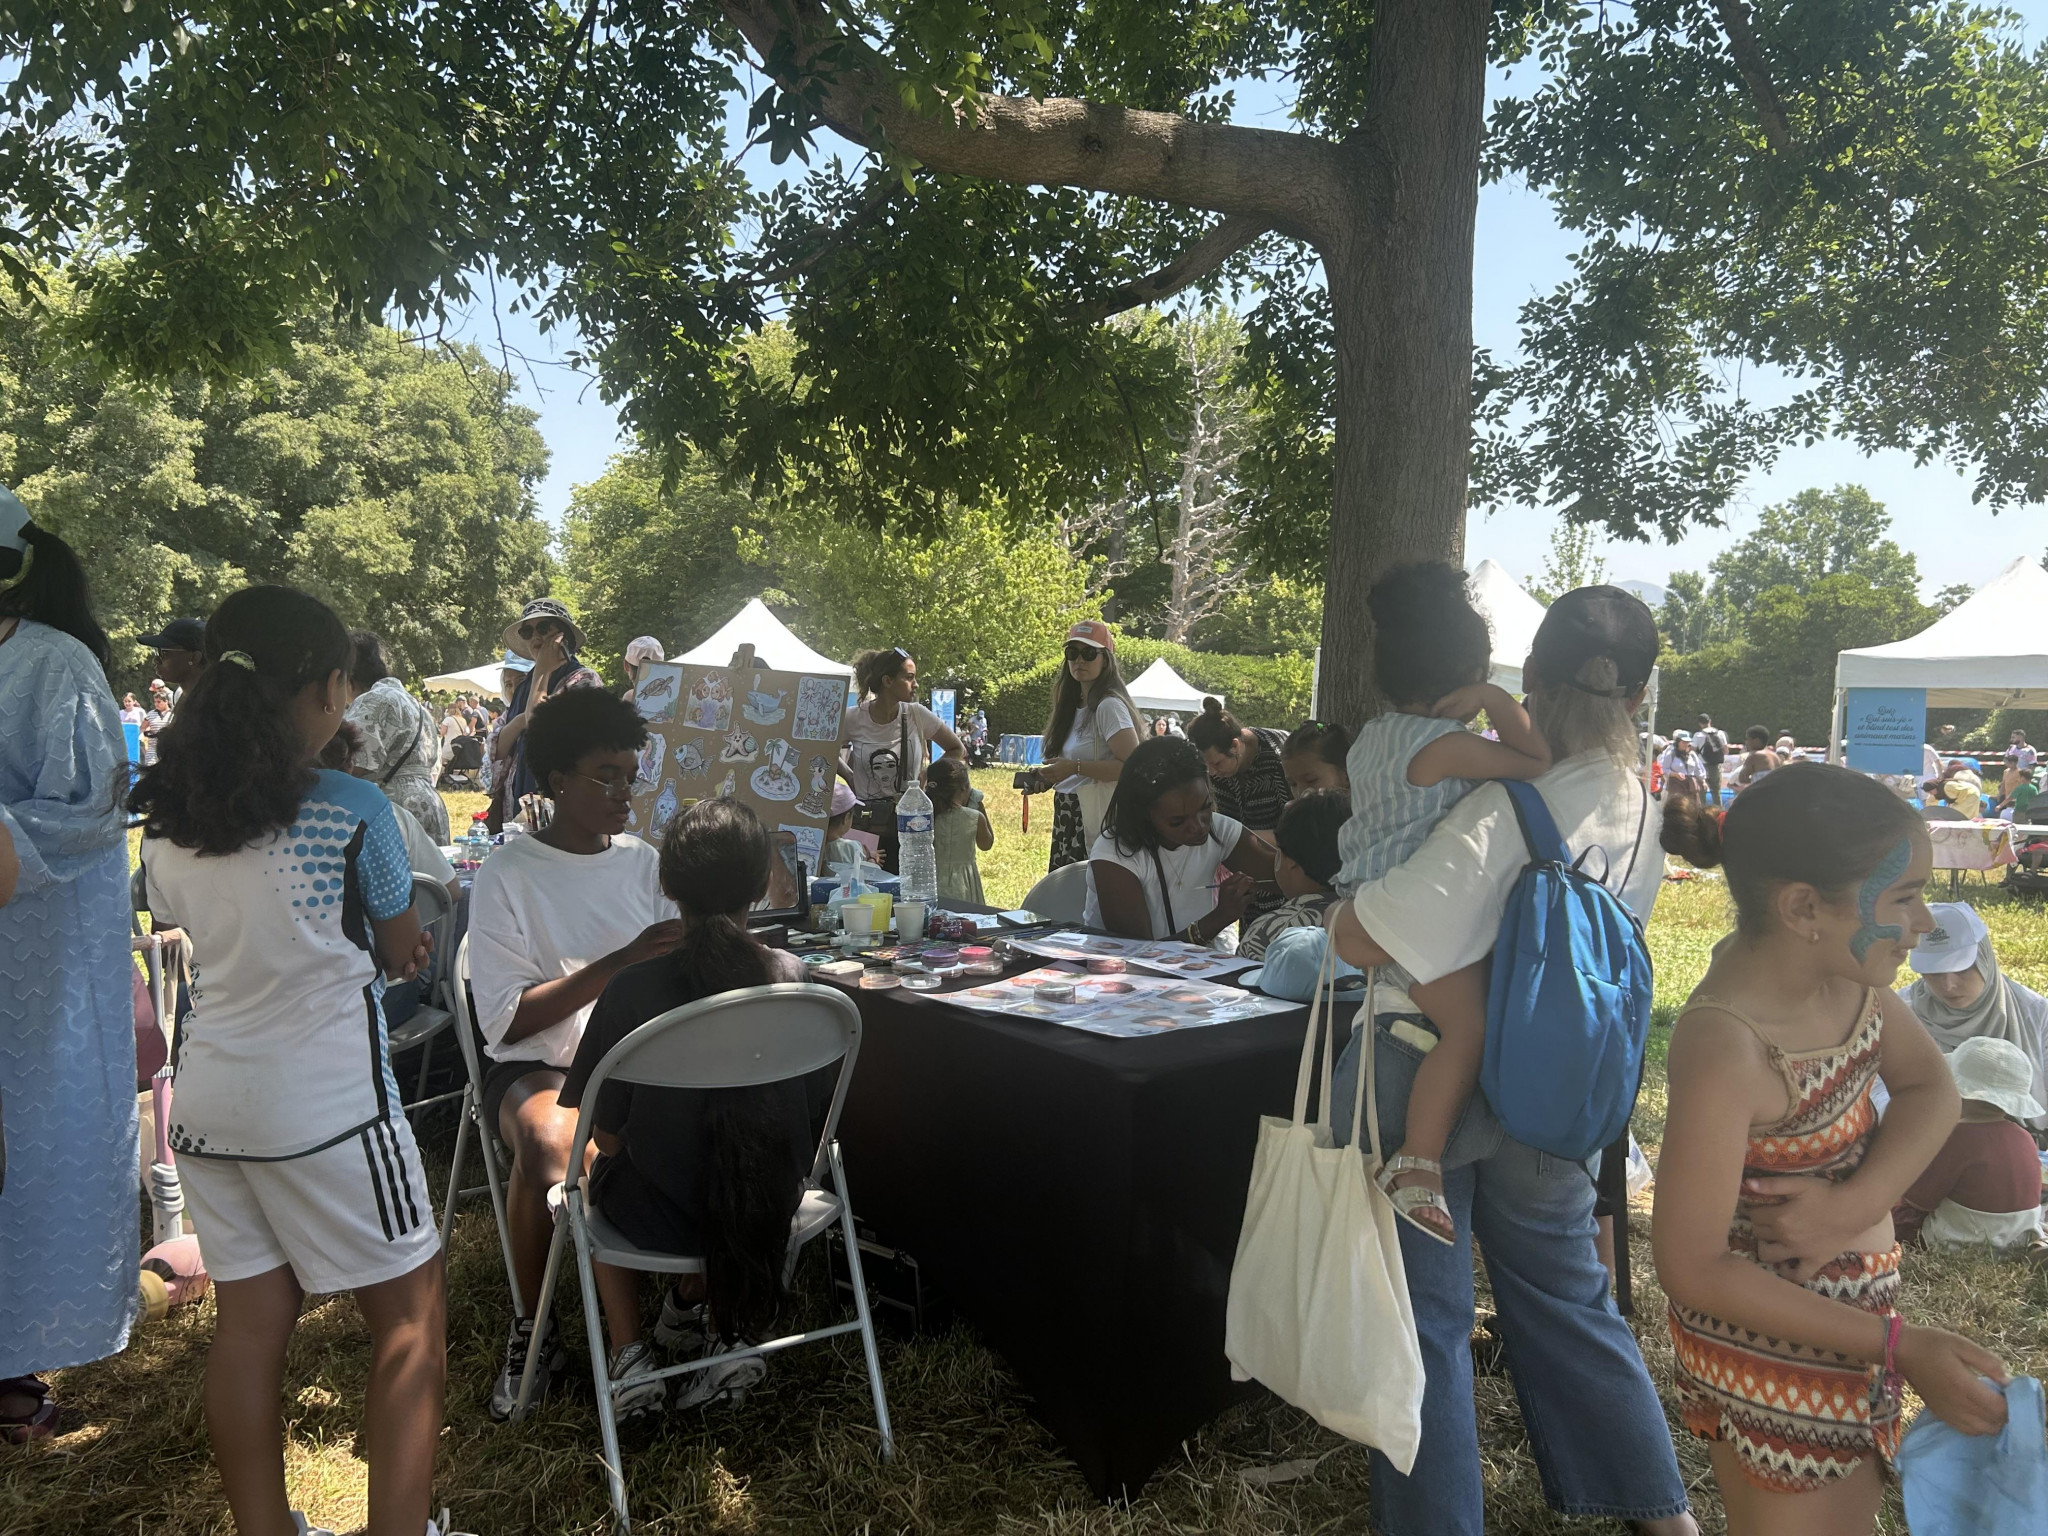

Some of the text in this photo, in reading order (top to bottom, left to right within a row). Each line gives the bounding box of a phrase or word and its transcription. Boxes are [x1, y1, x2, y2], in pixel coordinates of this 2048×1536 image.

[1878, 705, 1896, 717] Quiz
[1865, 714, 1880, 724] Qui
[1881, 716, 1907, 724] suis-je
[1866, 723, 1886, 731] blind
